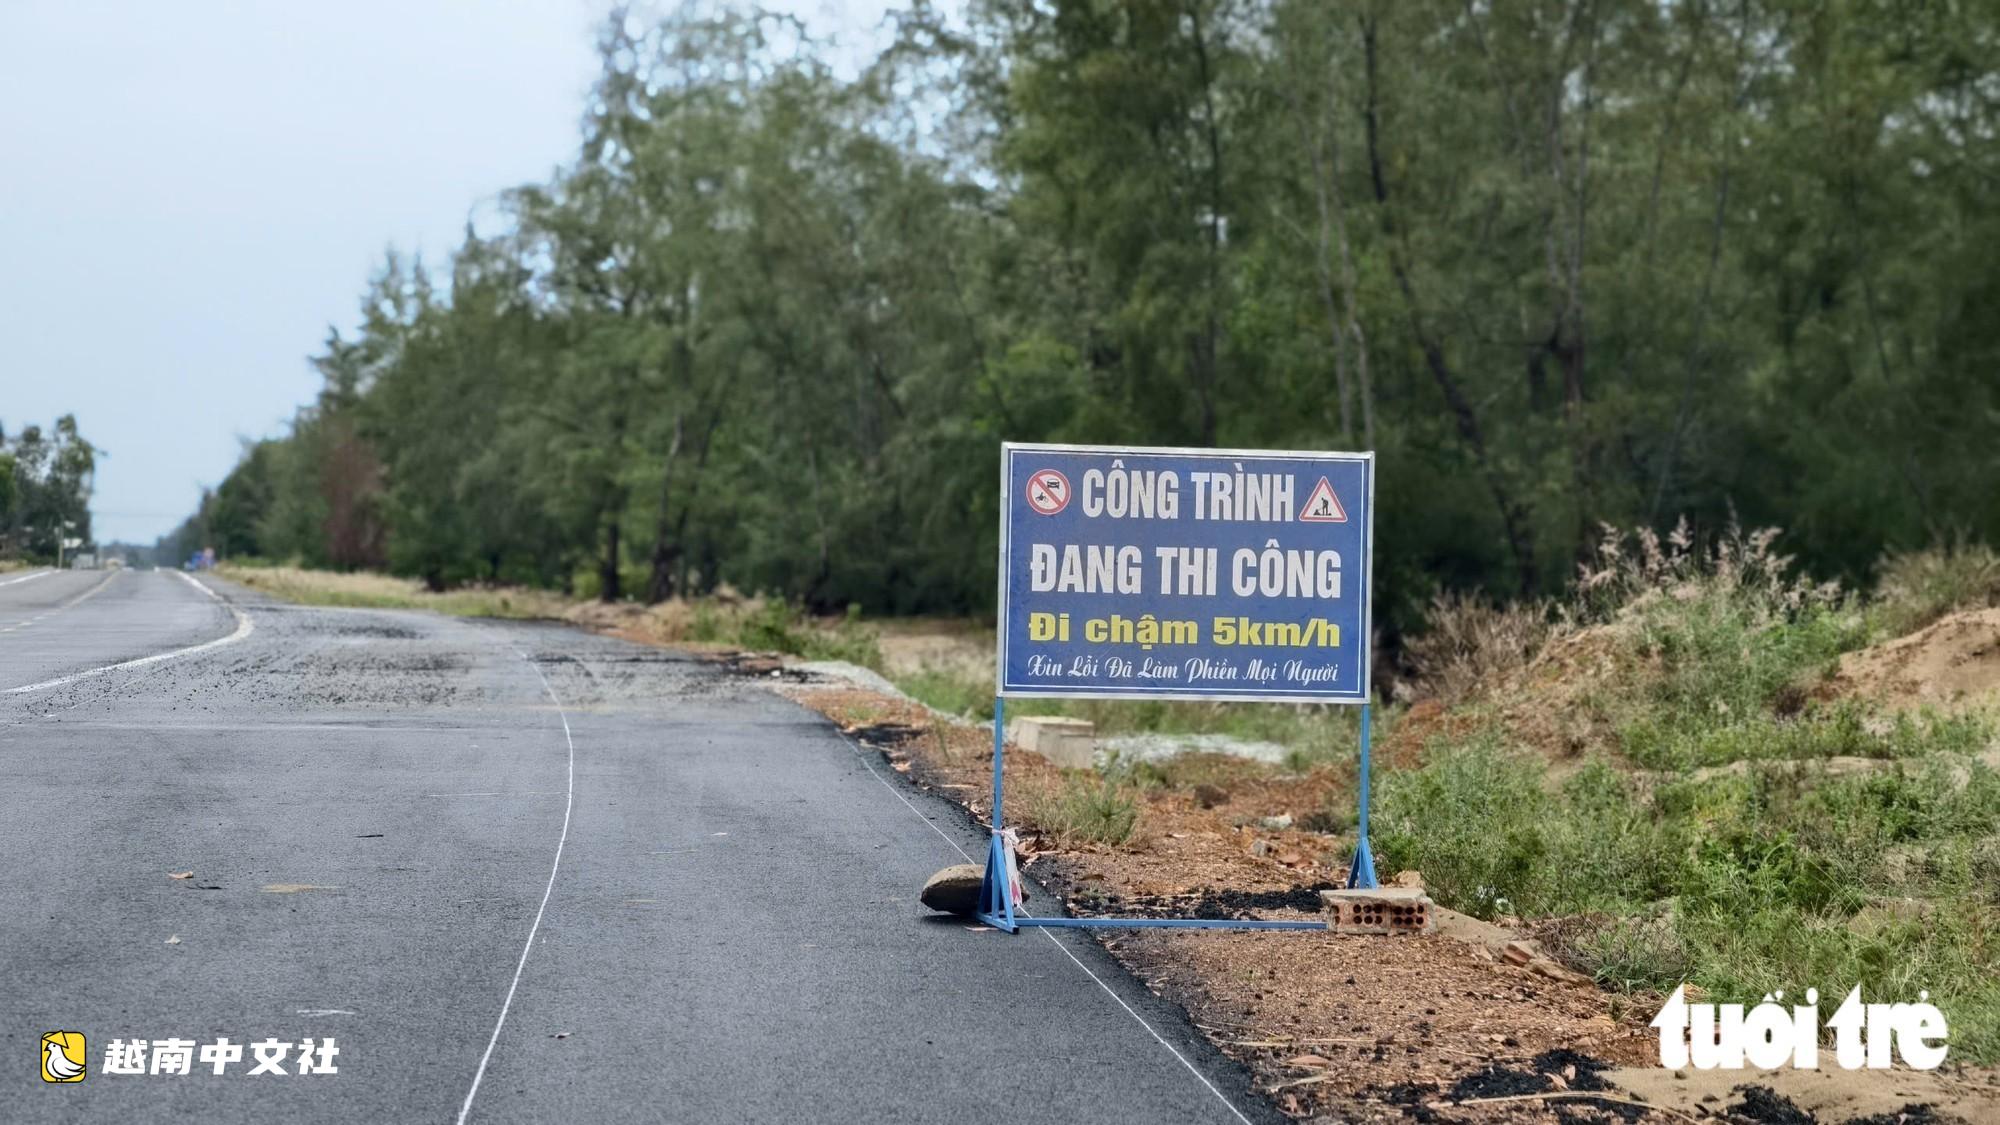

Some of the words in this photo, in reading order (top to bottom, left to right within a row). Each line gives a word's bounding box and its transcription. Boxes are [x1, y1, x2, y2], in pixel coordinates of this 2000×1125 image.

[1082, 459, 1180, 519] CÔNG
[1190, 463, 1295, 522] TRÌNH
[1031, 543, 1143, 594] ĐANG
[1156, 546, 1218, 596] THI
[1232, 539, 1342, 598] CÔNG
[1028, 612, 1070, 642] Đi
[1085, 614, 1198, 650] chậm
[1212, 616, 1341, 648] 5km/h
[1028, 655, 1063, 677] Xin
[1068, 655, 1099, 678] Lỗi
[1105, 656, 1133, 678] Đã
[1137, 656, 1179, 679] Làm
[1184, 657, 1238, 683] Phiền
[1242, 658, 1278, 685] Mọi
[1283, 659, 1339, 686] Người
